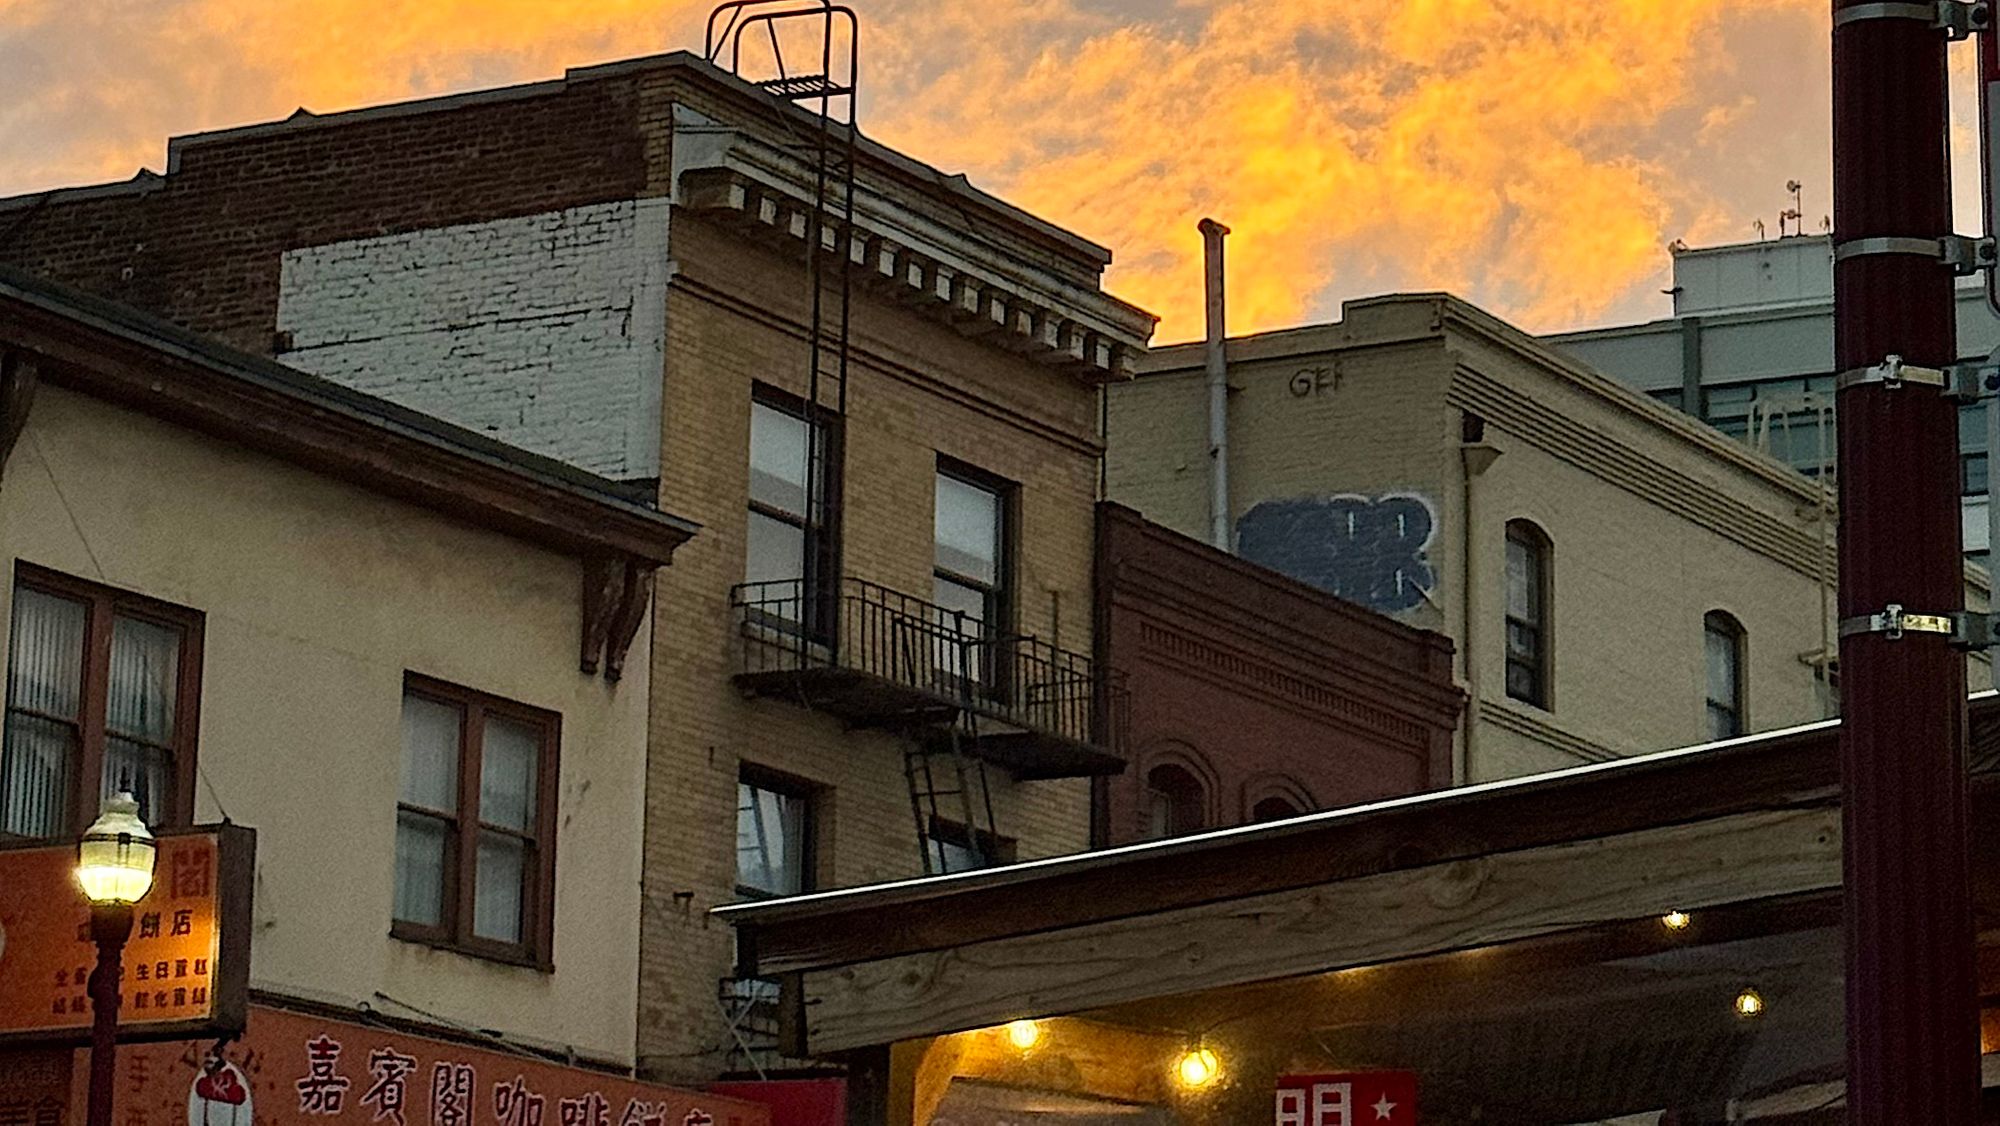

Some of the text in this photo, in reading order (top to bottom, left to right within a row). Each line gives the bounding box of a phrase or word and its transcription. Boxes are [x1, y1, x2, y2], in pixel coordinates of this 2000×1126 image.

[297, 1035, 711, 1126] 嘉賓閣咖啡
